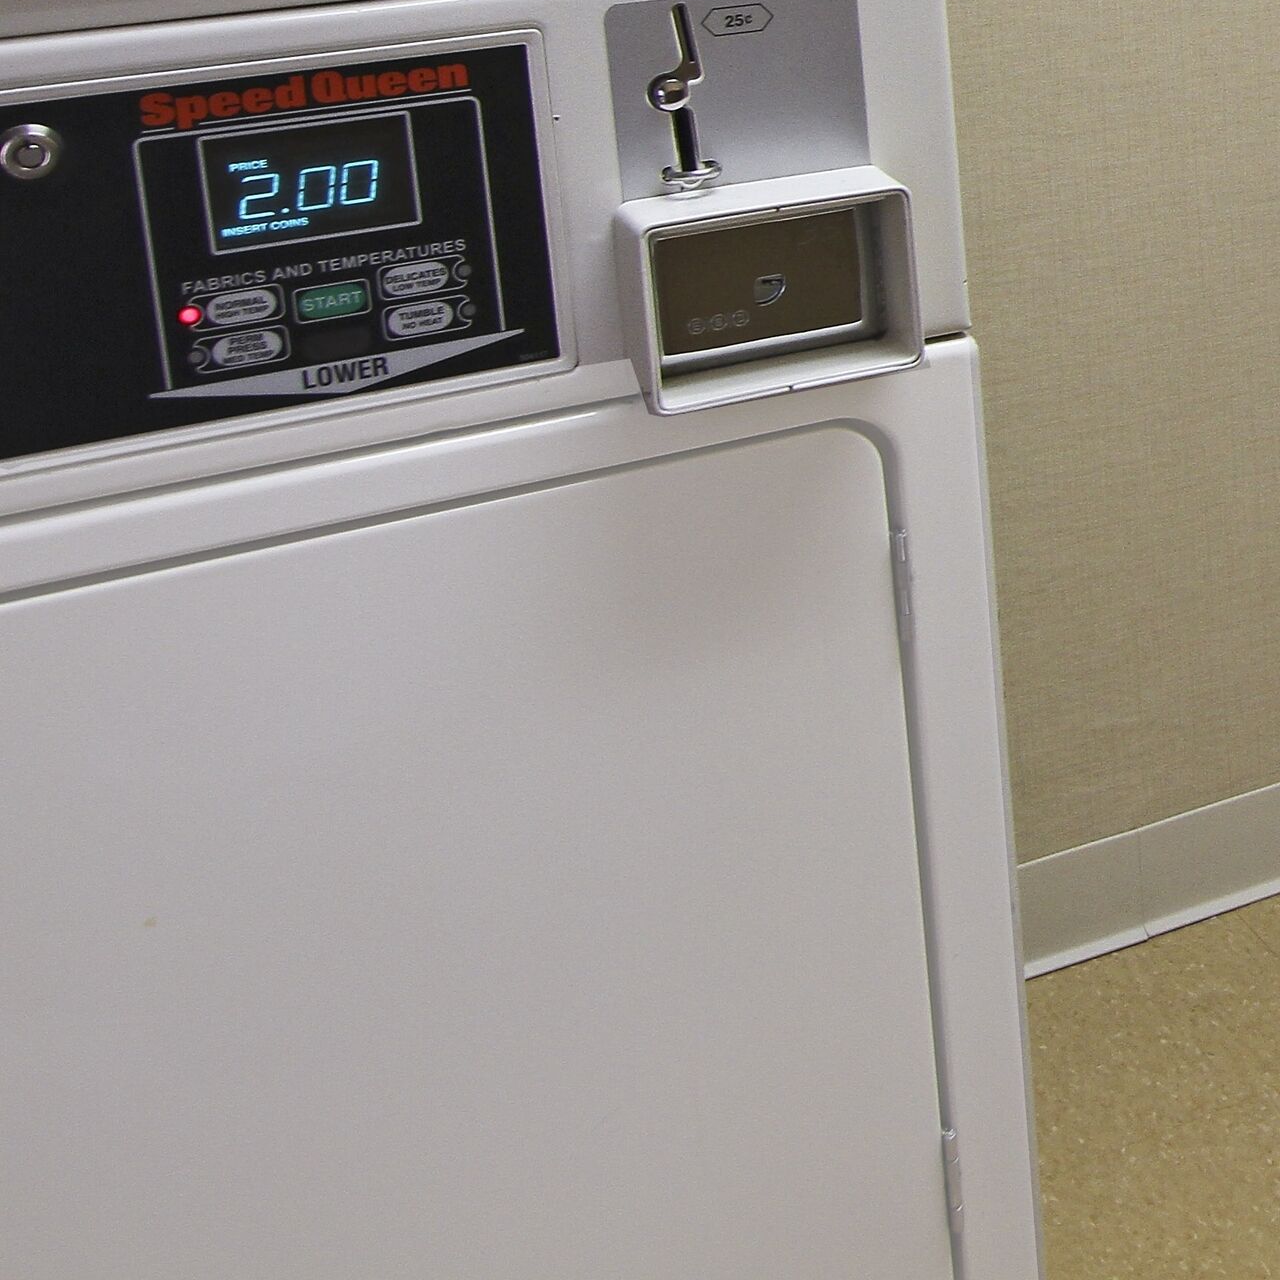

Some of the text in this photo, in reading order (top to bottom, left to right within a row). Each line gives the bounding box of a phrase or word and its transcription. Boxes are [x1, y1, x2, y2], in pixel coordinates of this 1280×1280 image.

[139, 63, 470, 130] Speed Queen
[228, 159, 268, 173] PRICE
[239, 159, 379, 220] 2.00
[221, 217, 309, 238] INSERT COINS
[181, 239, 466, 295] FABRICS AND TEMPERATURES
[385, 267, 447, 284] DELICATES
[392, 278, 441, 292] LOW TEMP
[215, 296, 267, 311] NORMAL
[302, 291, 362, 312] START
[399, 306, 446, 321] TUMBLE
[402, 317, 443, 331] NO HEAT
[228, 341, 267, 354] PRESS
[230, 333, 264, 346] PERM
[302, 357, 388, 389] LOWER
